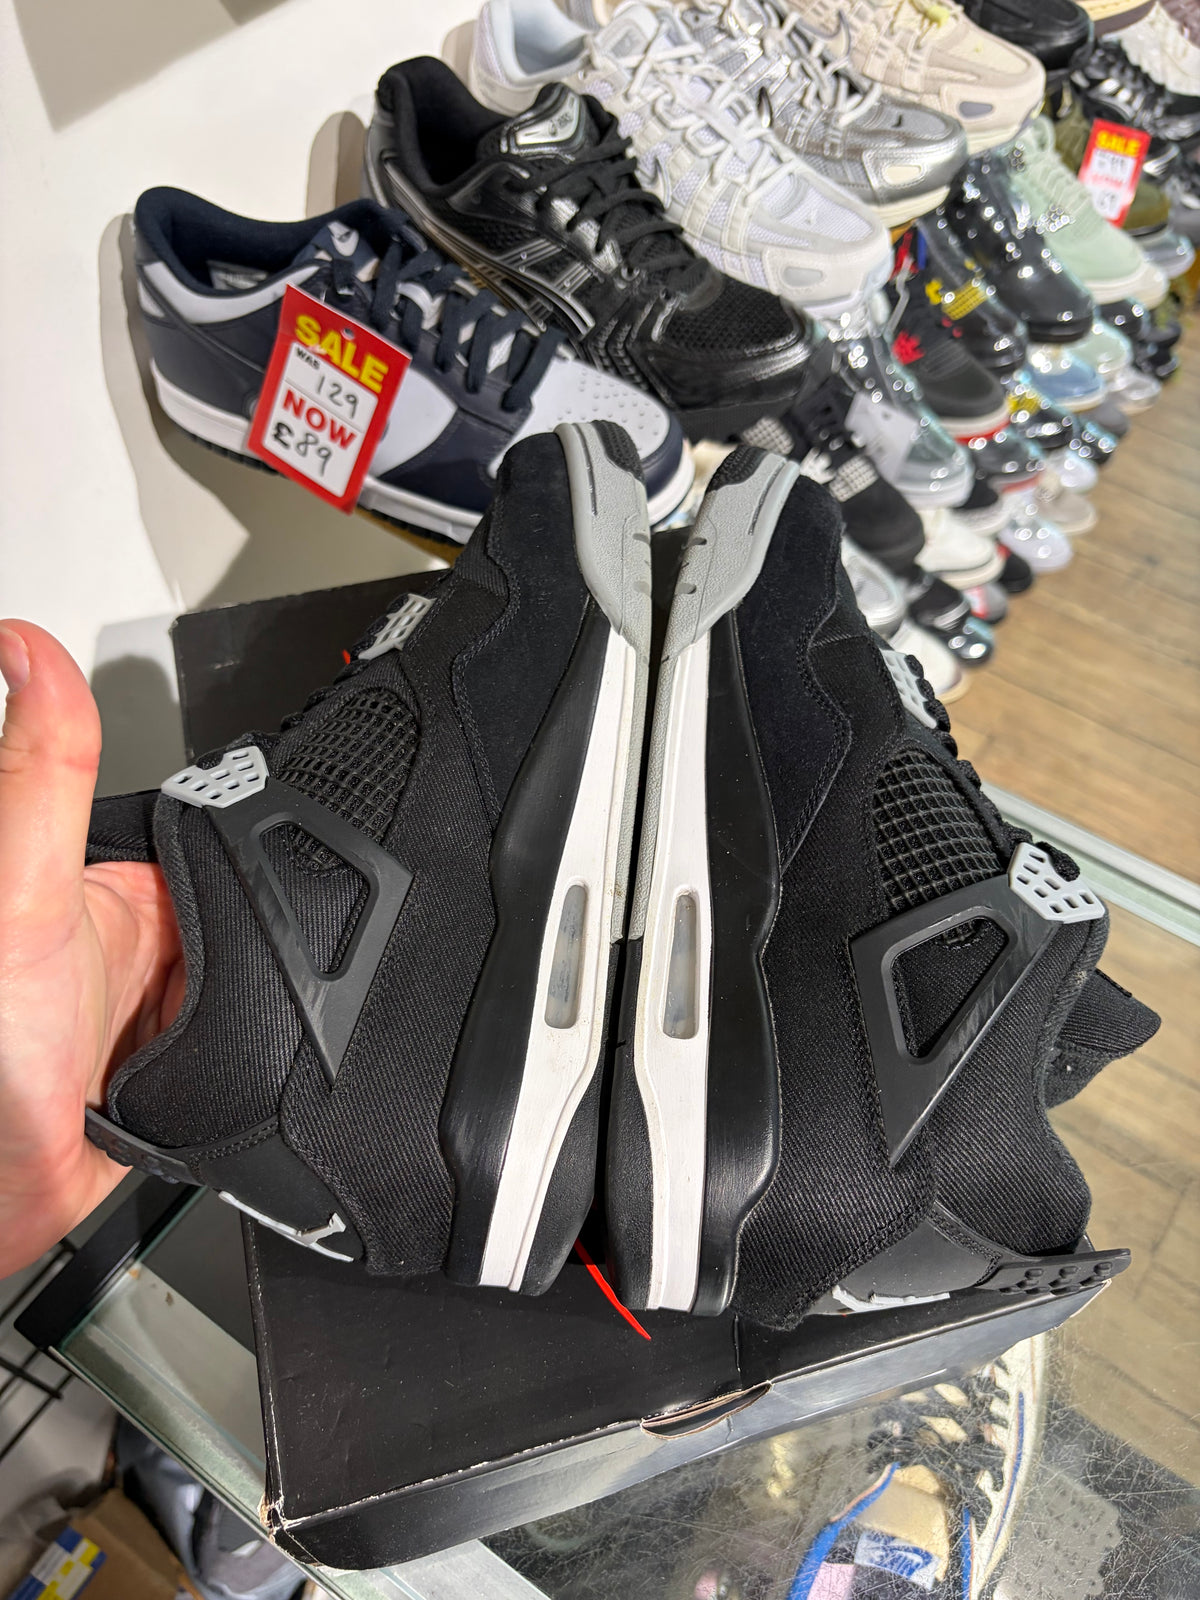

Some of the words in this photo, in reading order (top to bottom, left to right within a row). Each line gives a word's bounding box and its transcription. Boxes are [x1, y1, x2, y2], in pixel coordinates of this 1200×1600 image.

[294, 346, 321, 371] WAS
[295, 314, 389, 394] SALE
[282, 389, 358, 450] NOW
[316, 375, 360, 418] 129
[271, 421, 333, 477] £89
